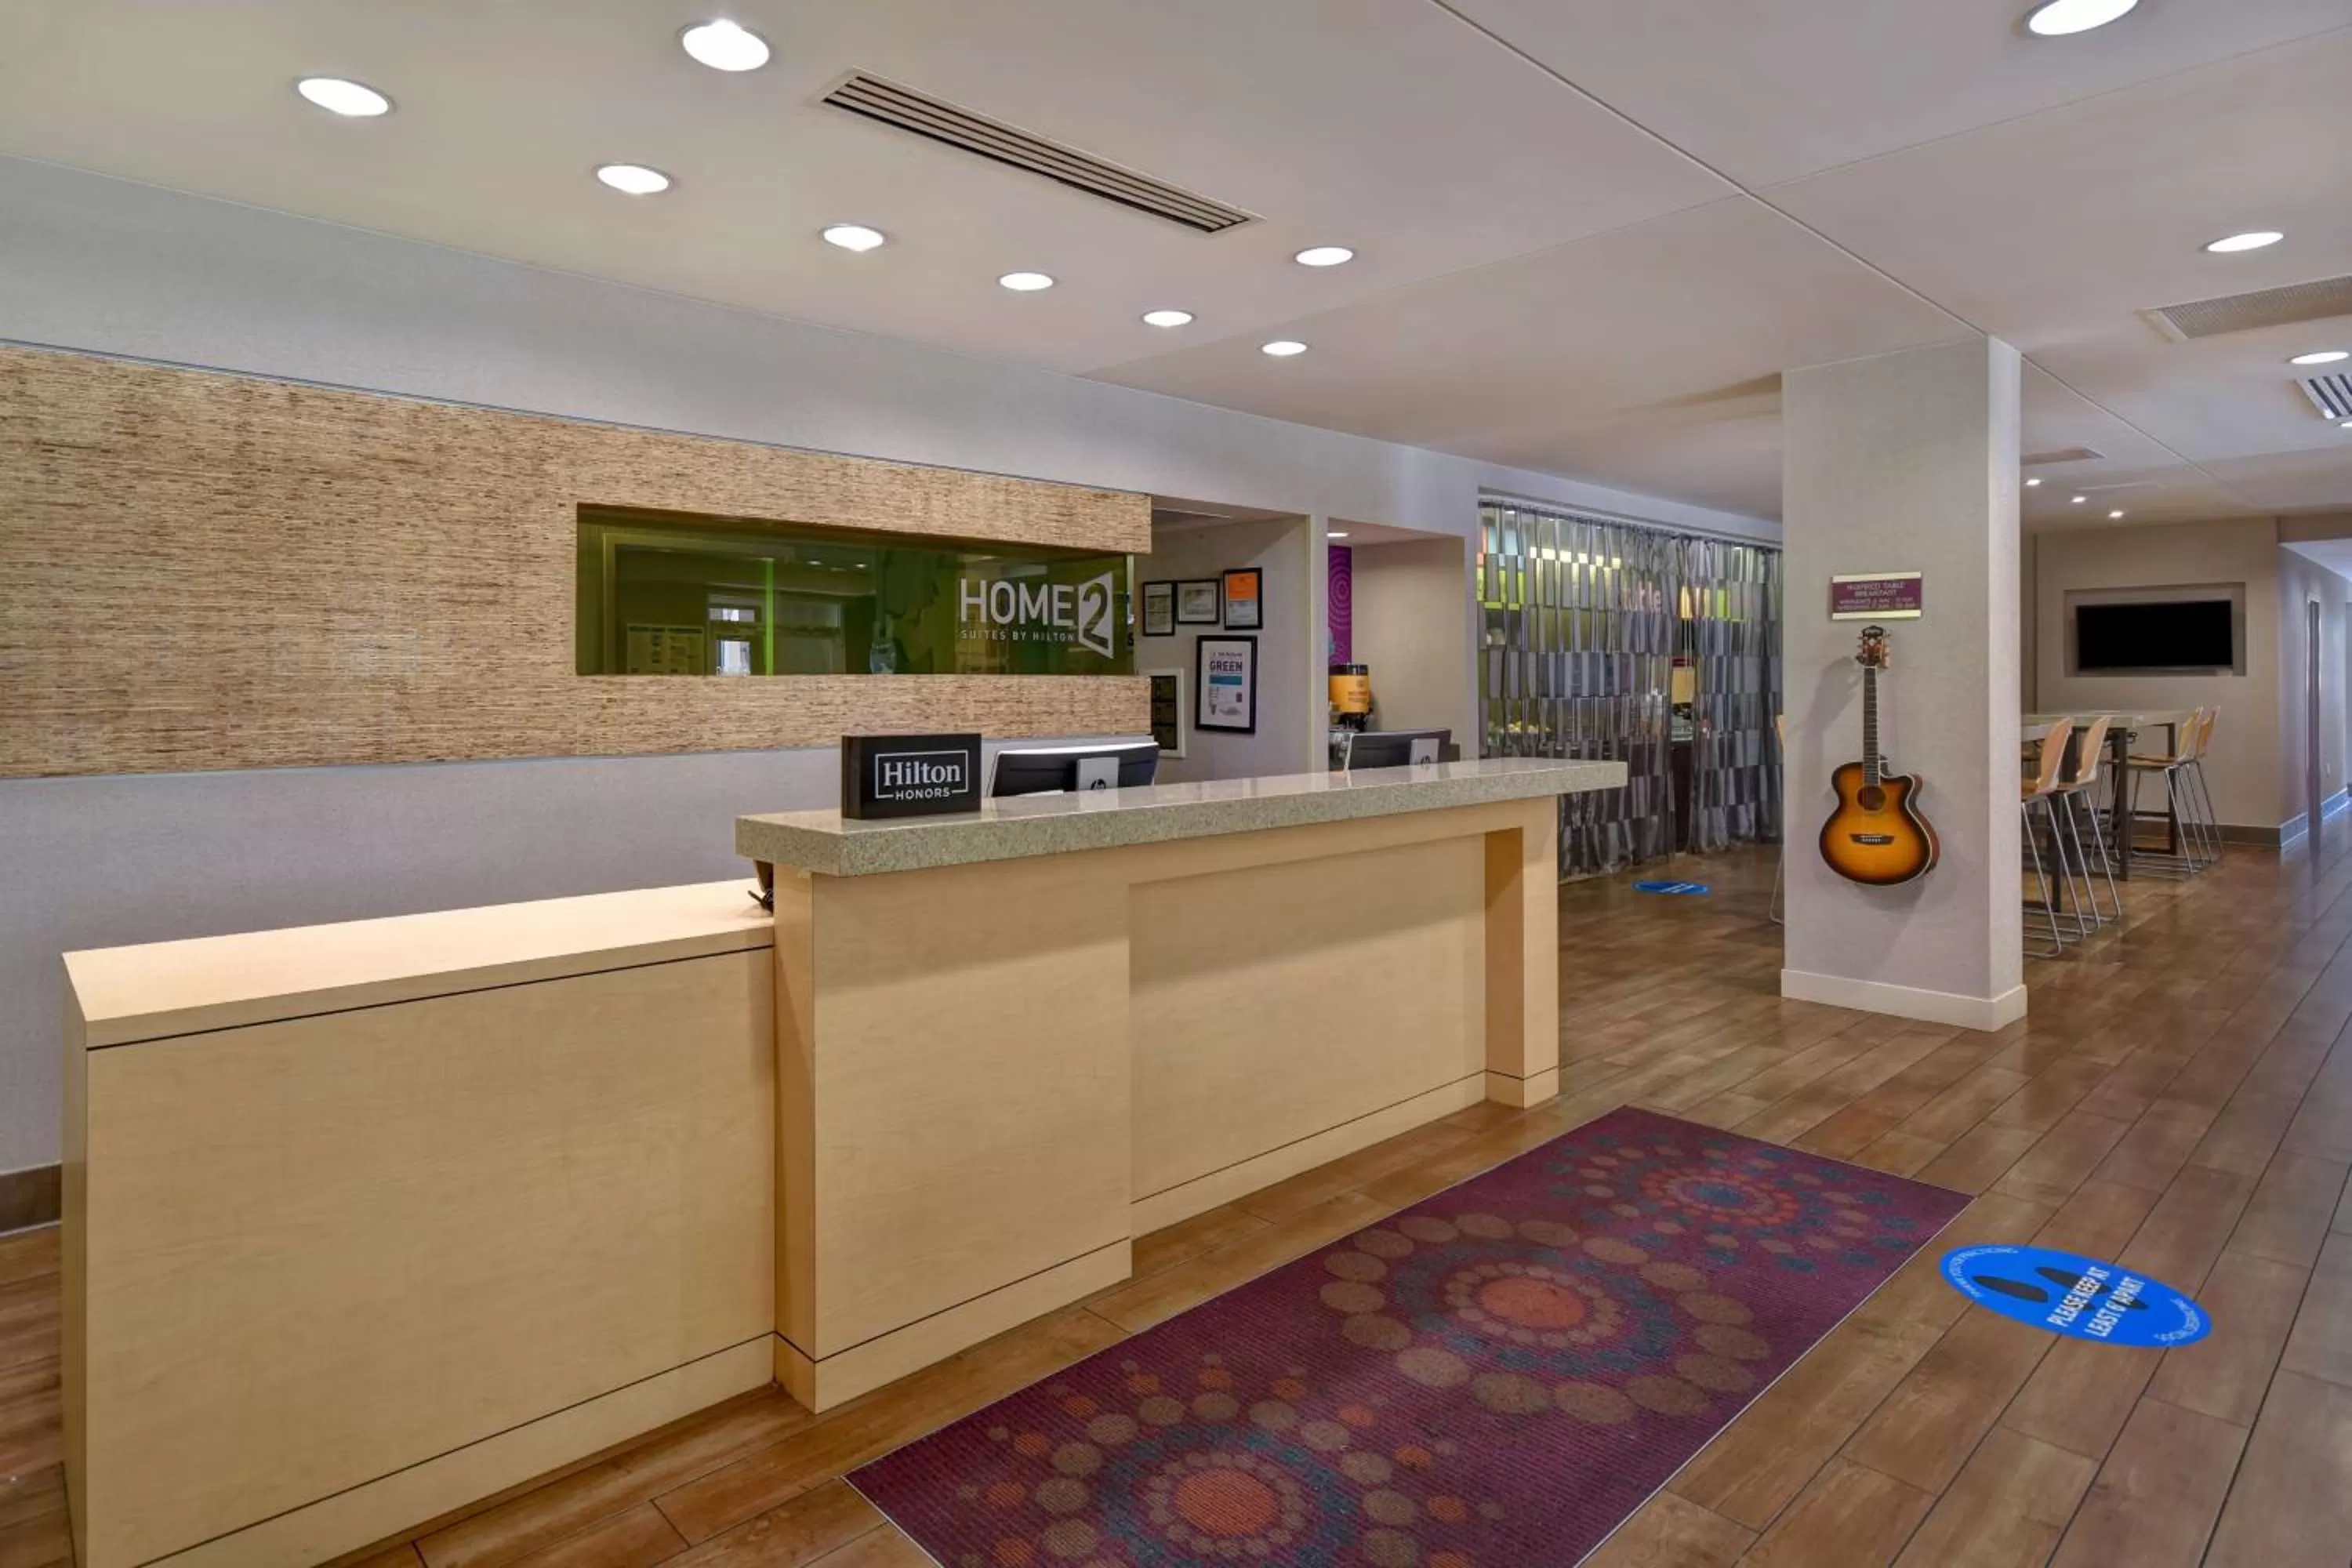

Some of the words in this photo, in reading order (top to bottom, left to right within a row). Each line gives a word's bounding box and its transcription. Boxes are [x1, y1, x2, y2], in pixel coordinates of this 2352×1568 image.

[960, 630, 1007, 641] SUITES
[1012, 630, 1027, 641] BY
[1033, 631, 1075, 642] HILTON
[1210, 660, 1243, 672] GREEN
[884, 760, 962, 786] Hilton
[895, 786, 951, 800] HONORS
[2045, 1294, 2089, 1327] PLEASE
[2070, 1276, 2102, 1299] KEEP
[2083, 1307, 2122, 1337] LEAST
[2110, 1276, 2145, 1305] APART
